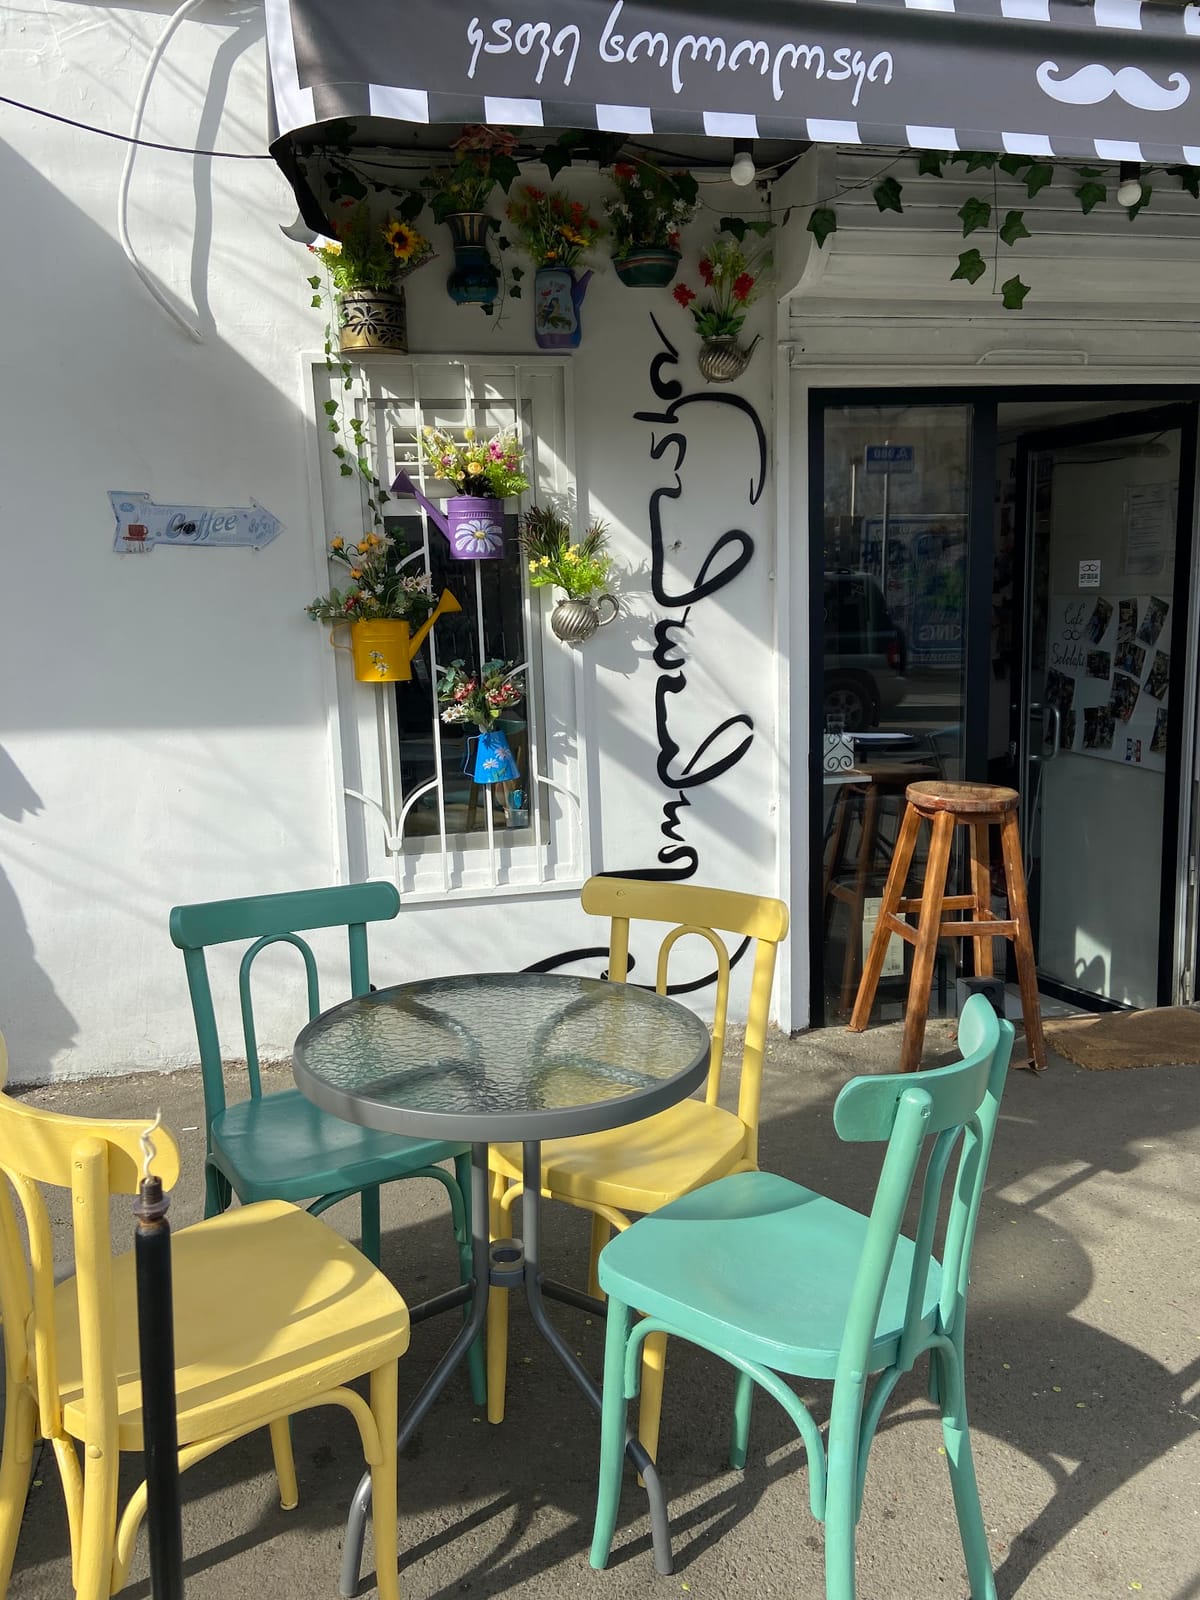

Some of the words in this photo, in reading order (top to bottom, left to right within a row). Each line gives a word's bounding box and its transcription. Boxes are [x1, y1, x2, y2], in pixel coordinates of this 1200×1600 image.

[466, 16, 581, 86] კაფე
[599, 0, 894, 107] სოლოლაკი
[165, 510, 238, 542] Coffee
[597, 311, 768, 880] სოლოლაკი
